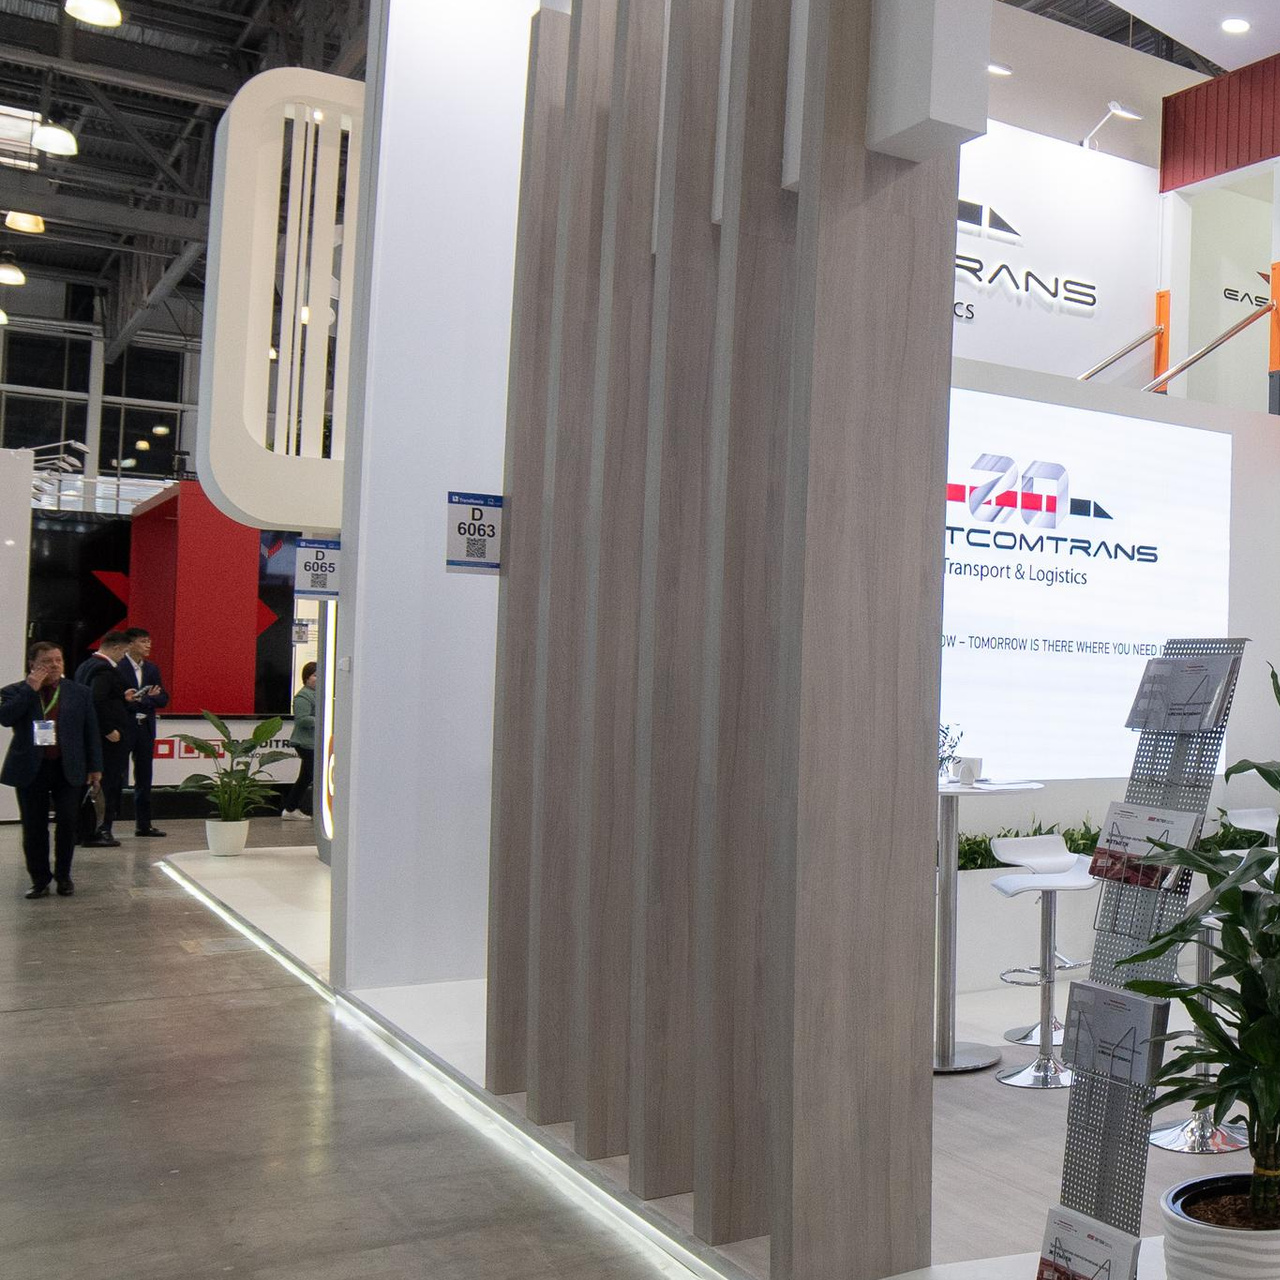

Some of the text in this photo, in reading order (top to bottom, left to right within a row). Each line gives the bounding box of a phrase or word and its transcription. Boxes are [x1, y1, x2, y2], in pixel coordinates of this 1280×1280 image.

[472, 507, 484, 522] D
[457, 521, 496, 538] 6063
[315, 550, 325, 561] D
[304, 561, 336, 573] 6065
[943, 557, 1088, 586] Transport & Logistics
[968, 635, 1028, 651] TOMORROW
[1030, 638, 1040, 651] IS
[1043, 639, 1074, 653] THERE
[1075, 641, 1110, 654] WHERE
[1112, 642, 1131, 655] YOU
[1132, 643, 1157, 656] NEED
